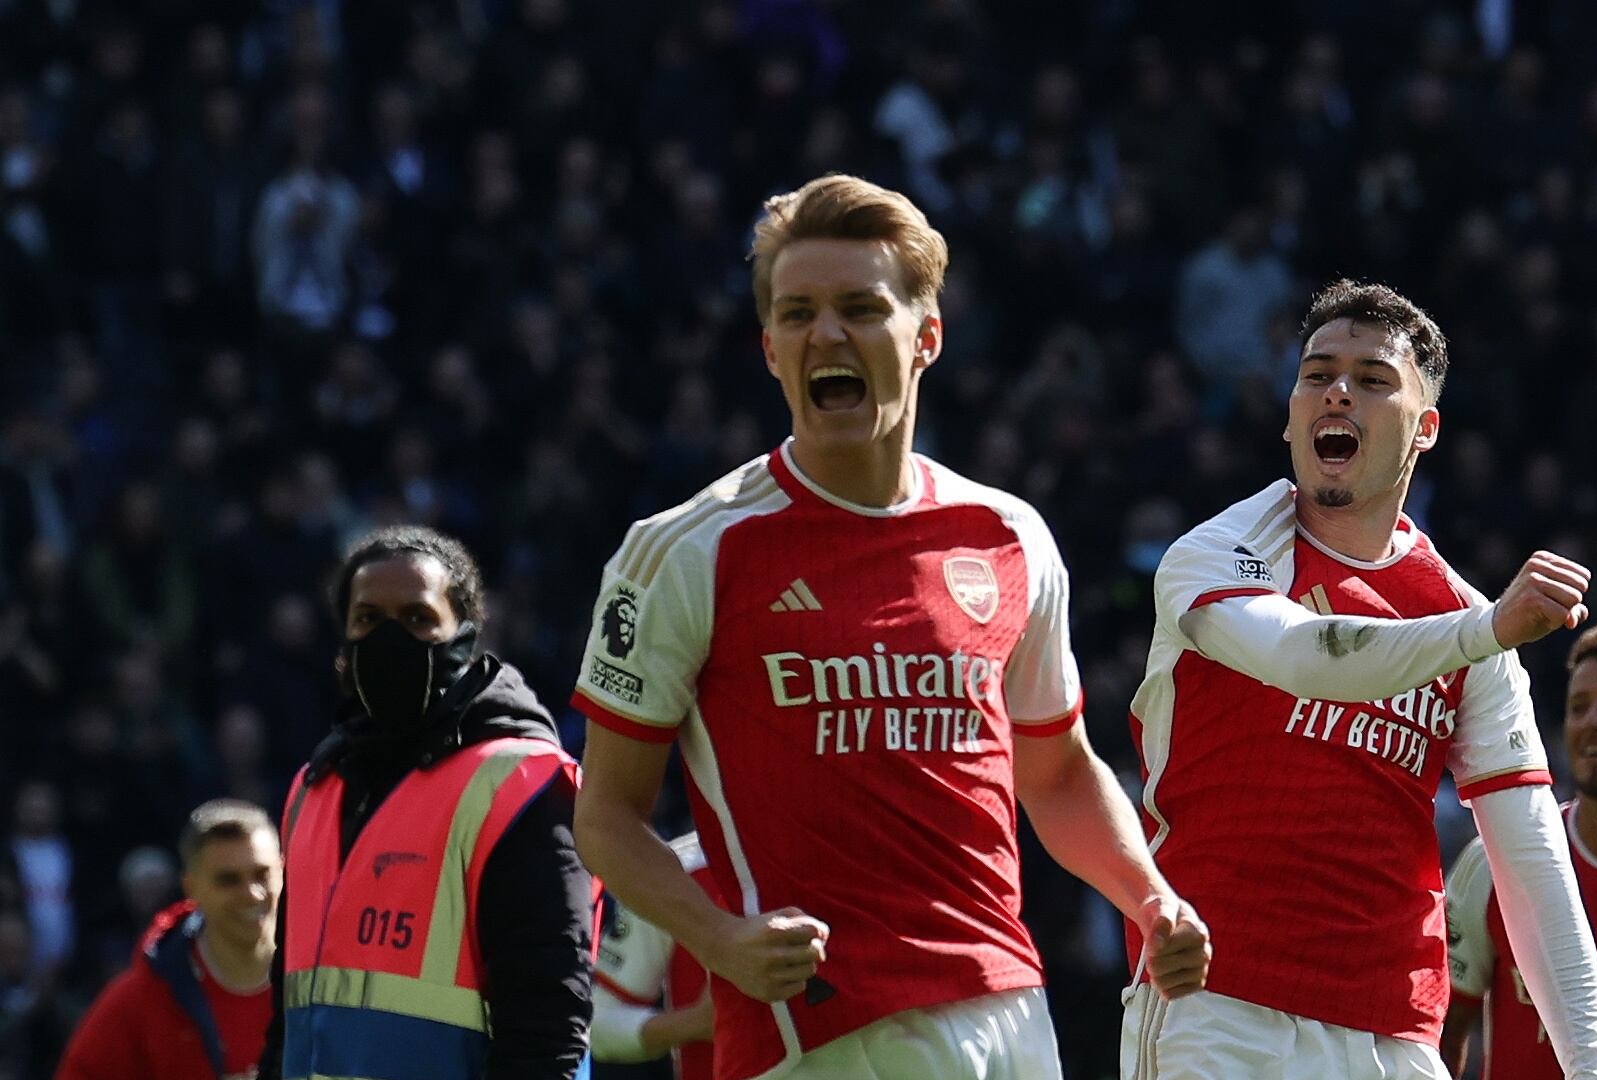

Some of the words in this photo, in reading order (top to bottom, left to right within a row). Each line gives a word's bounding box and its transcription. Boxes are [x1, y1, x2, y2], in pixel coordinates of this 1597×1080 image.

[816, 708, 873, 756] FLY
[884, 706, 983, 754] BETTER
[1284, 697, 1346, 742] FLY
[1347, 711, 1429, 778] BETTER
[1363, 683, 1456, 741] ates
[356, 906, 416, 950] 015
